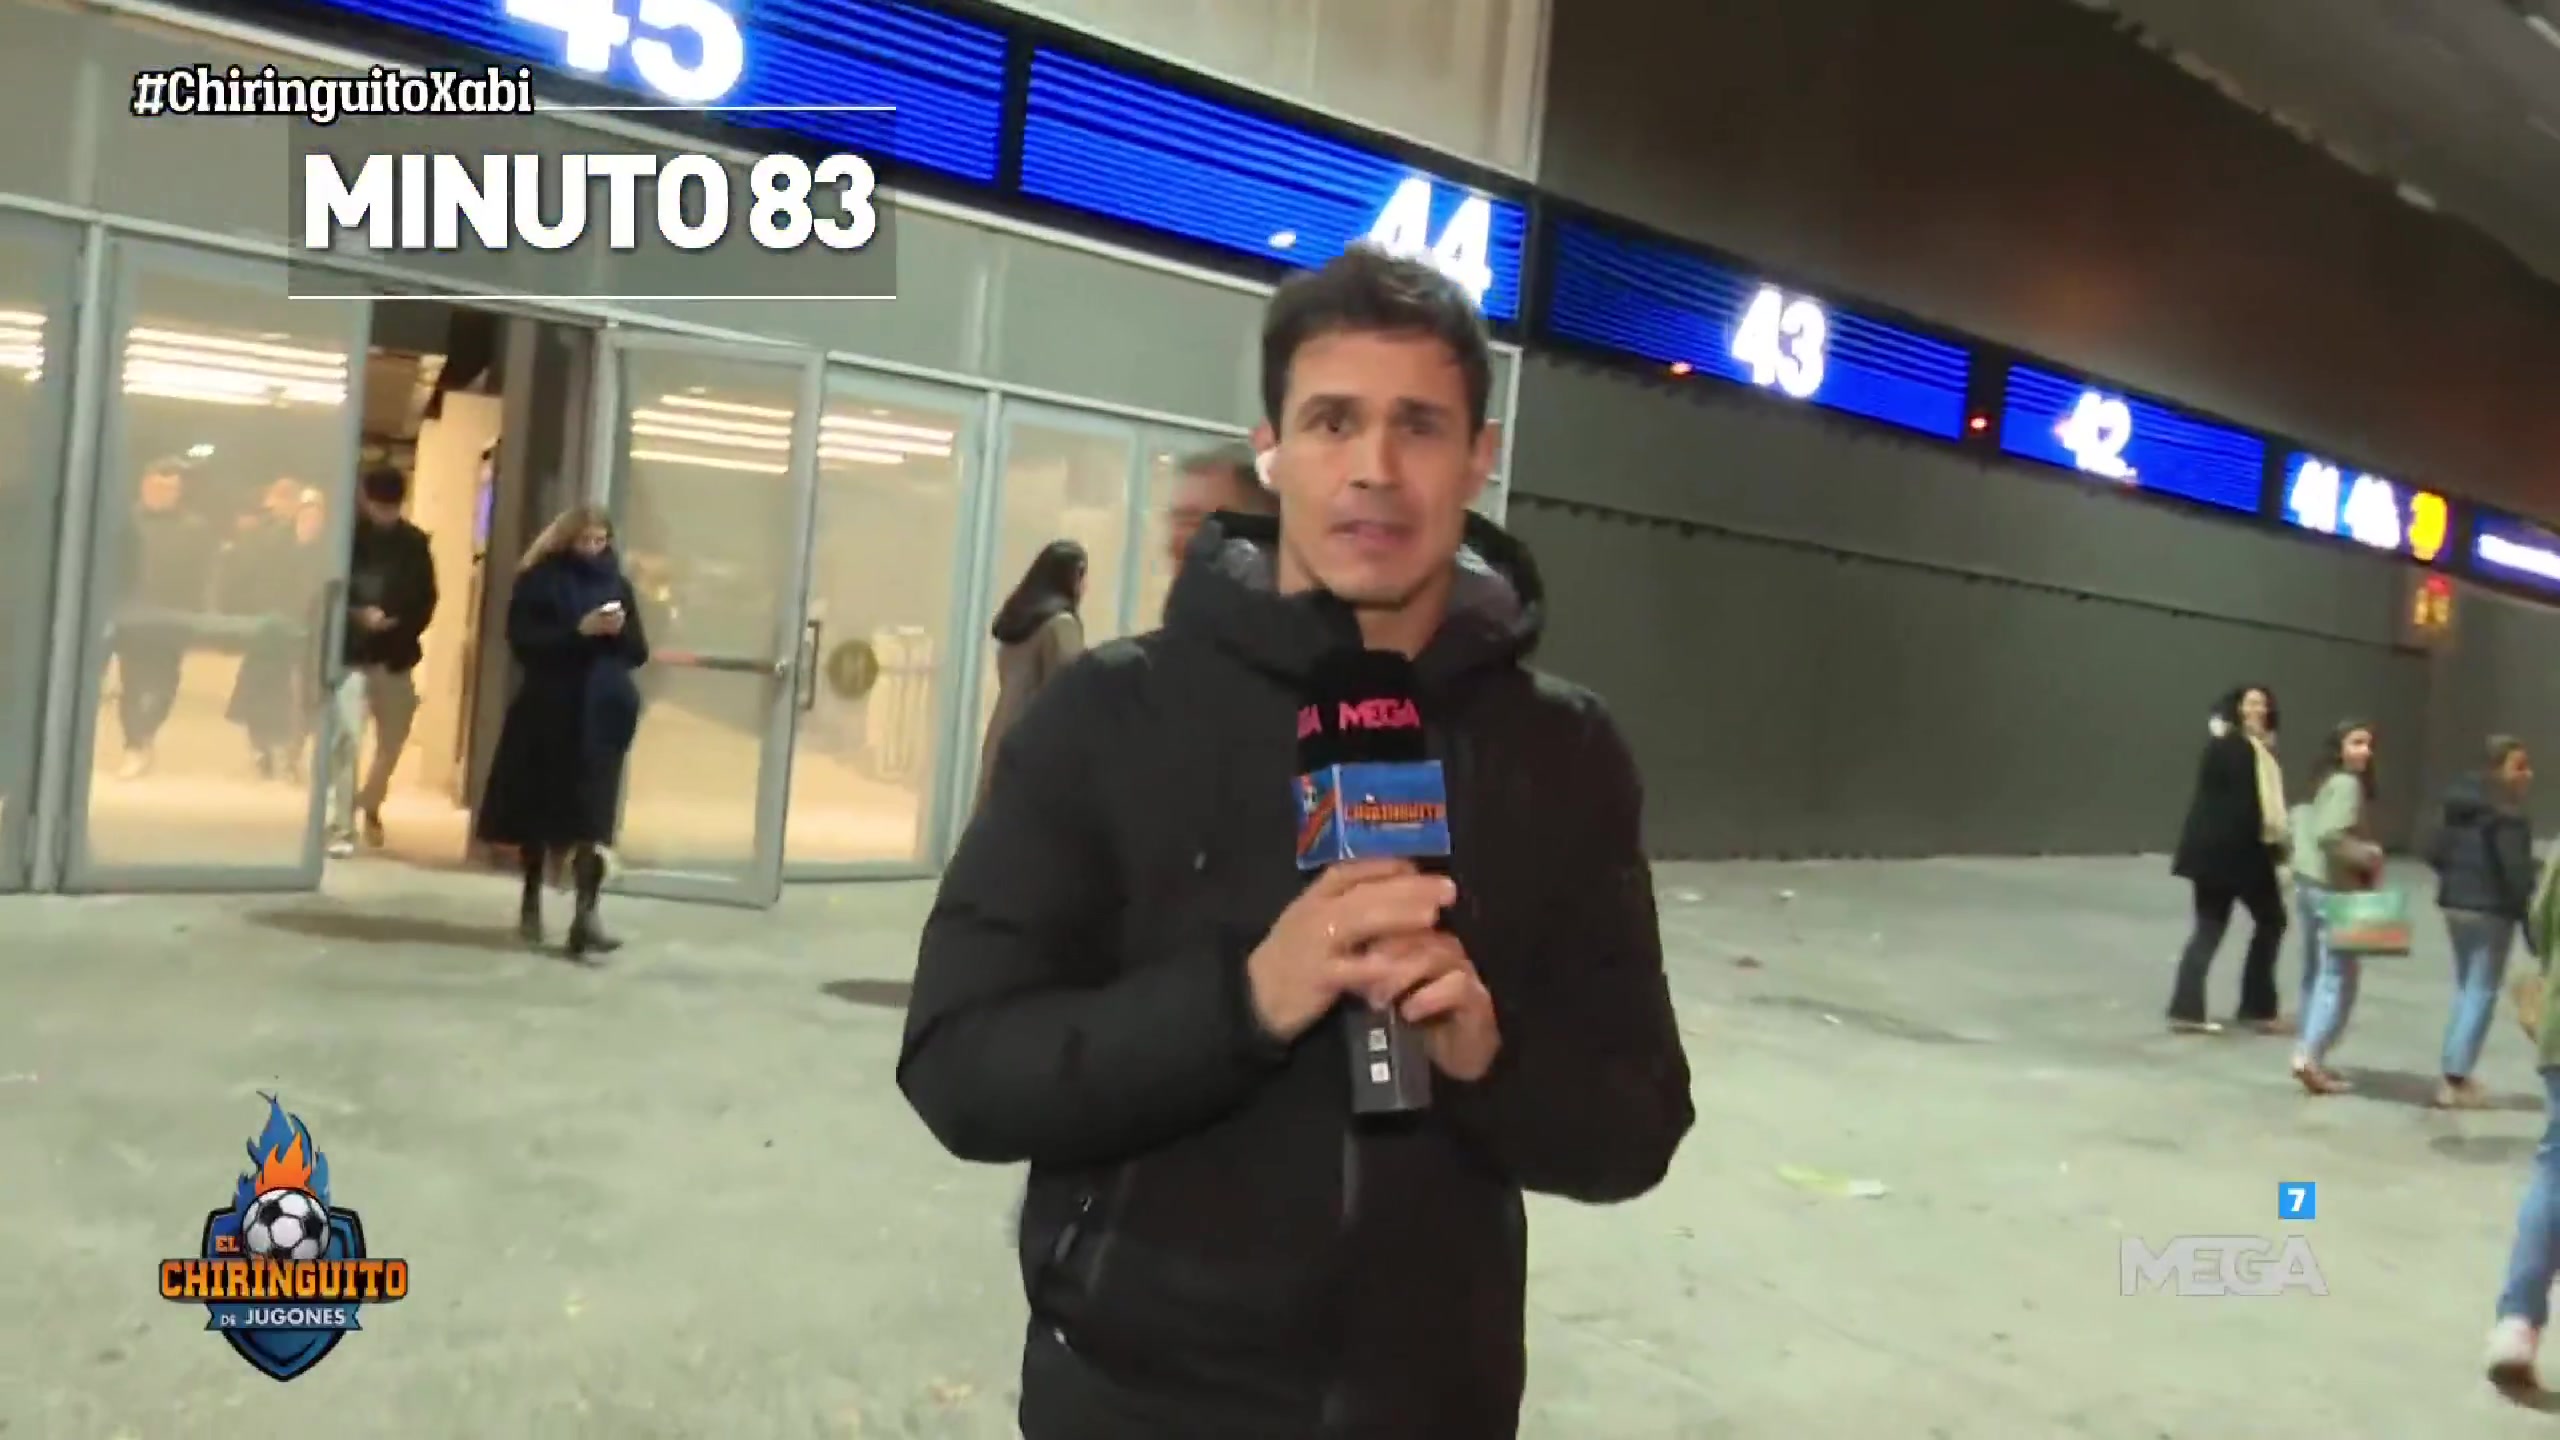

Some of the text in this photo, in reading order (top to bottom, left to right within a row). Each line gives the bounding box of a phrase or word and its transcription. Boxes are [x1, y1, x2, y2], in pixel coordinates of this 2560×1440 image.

[1732, 284, 1825, 397] 43
[2060, 391, 2137, 480] 42
[1338, 698, 1421, 730] MEGA
